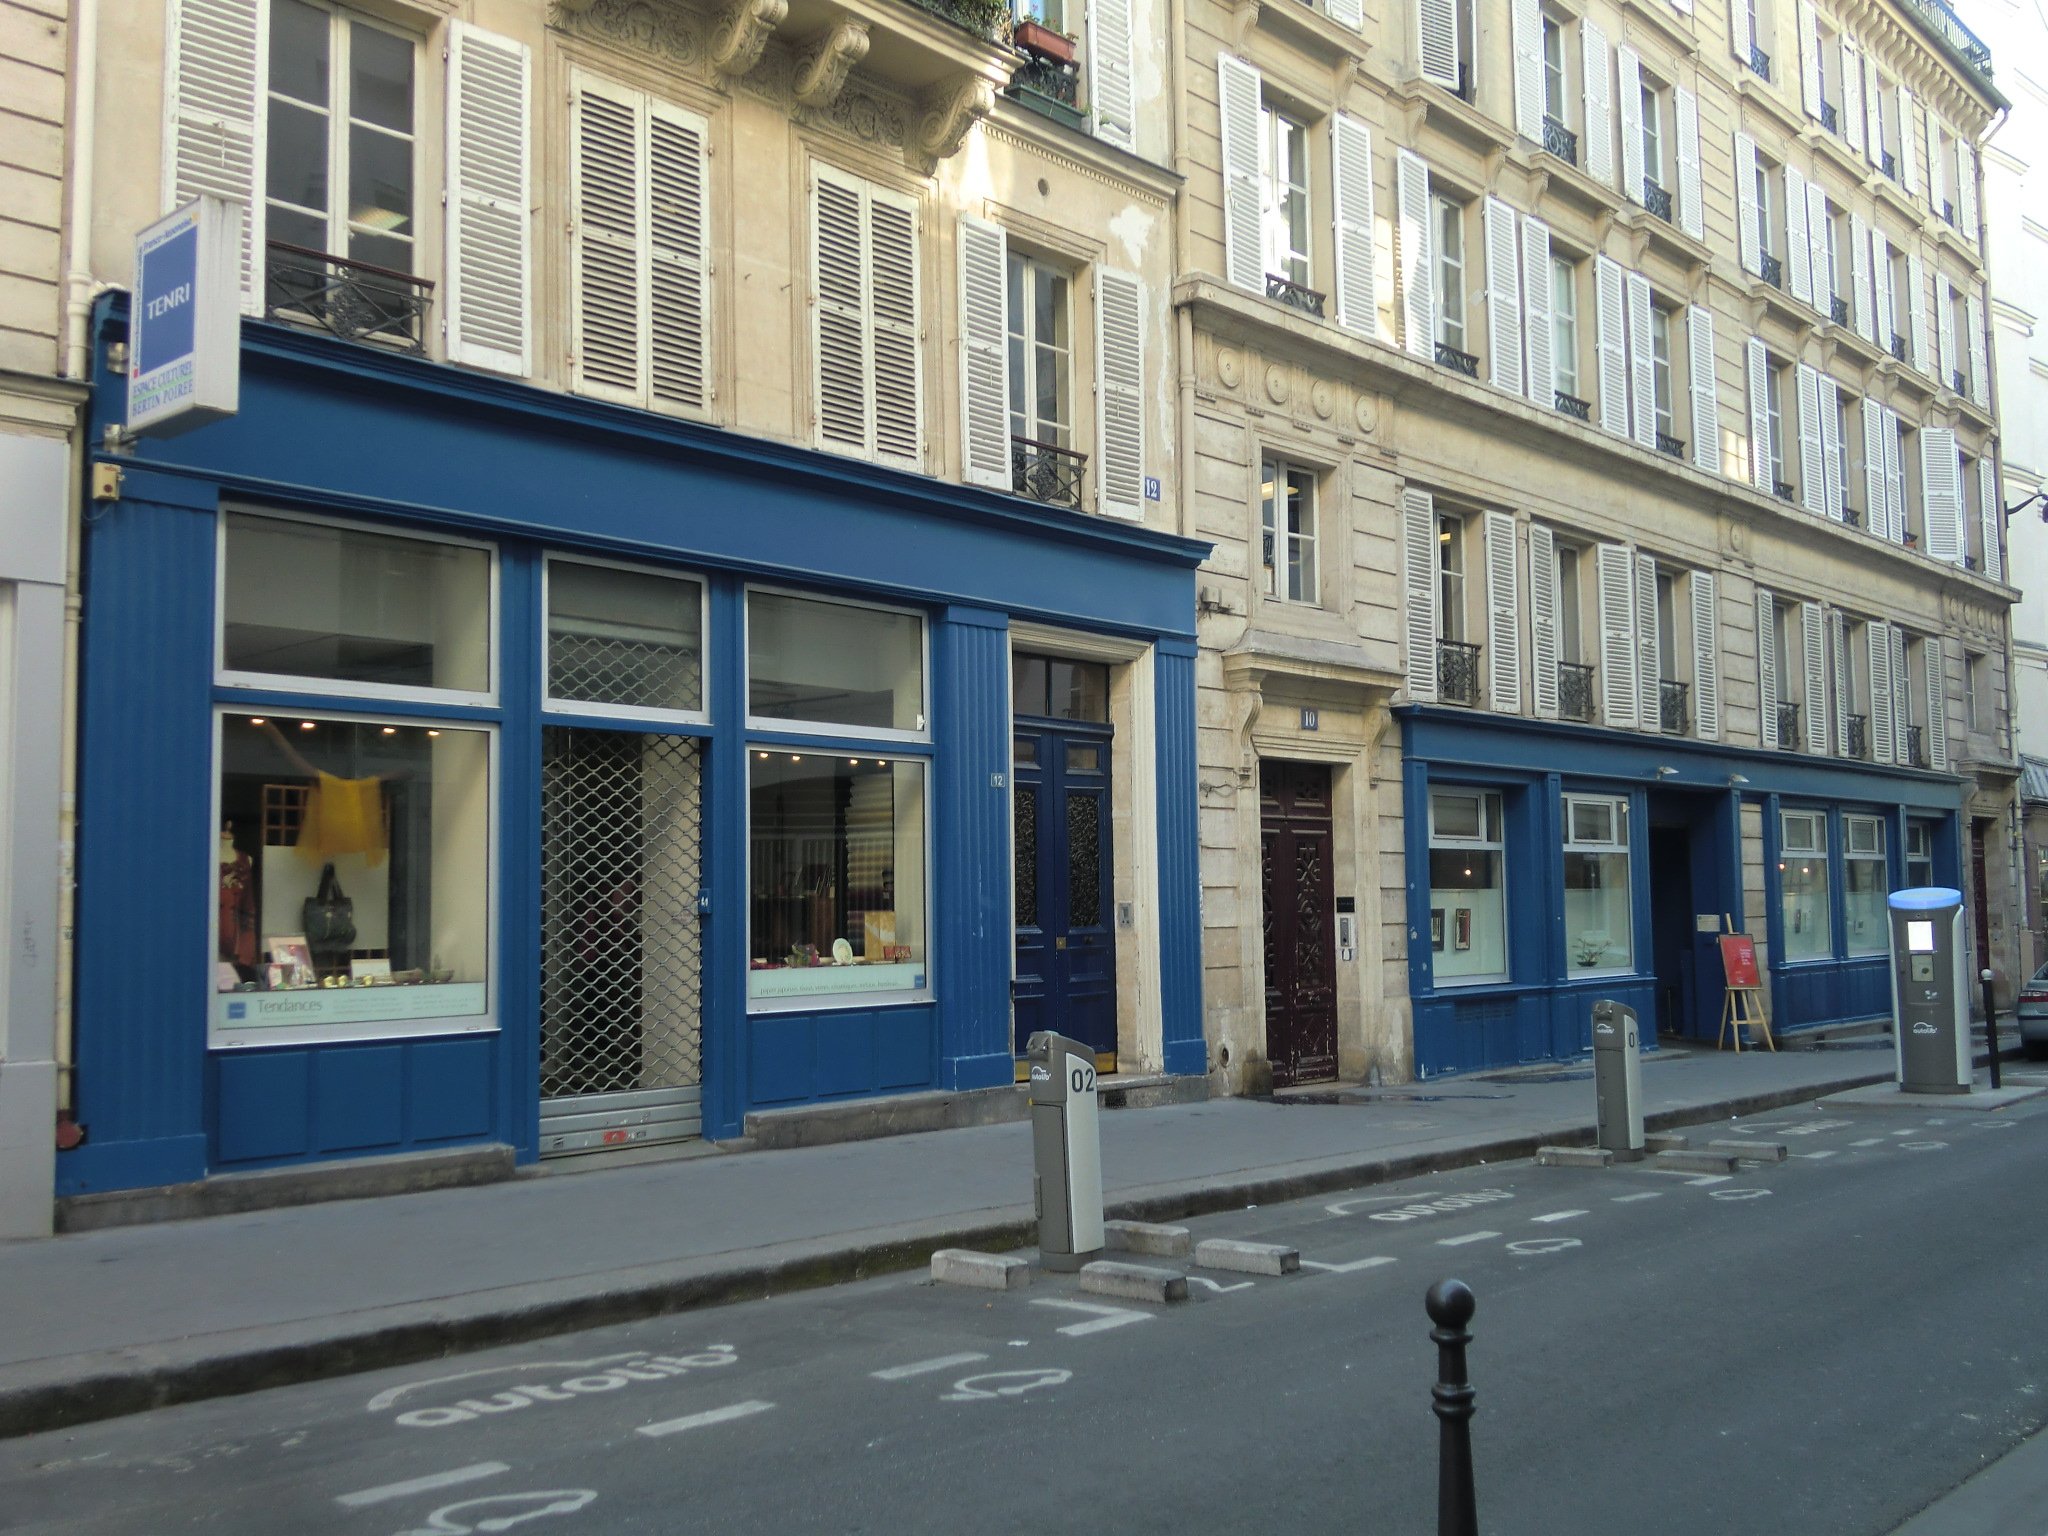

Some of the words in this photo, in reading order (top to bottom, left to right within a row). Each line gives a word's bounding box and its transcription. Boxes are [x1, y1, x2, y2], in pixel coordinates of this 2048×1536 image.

[147, 282, 190, 320] TENRI
[1146, 479, 1158, 498] 12
[1305, 711, 1315, 727] 10
[993, 775, 1003, 786] 12
[257, 998, 323, 1013] Tendances
[1071, 1068, 1095, 1093] 02
